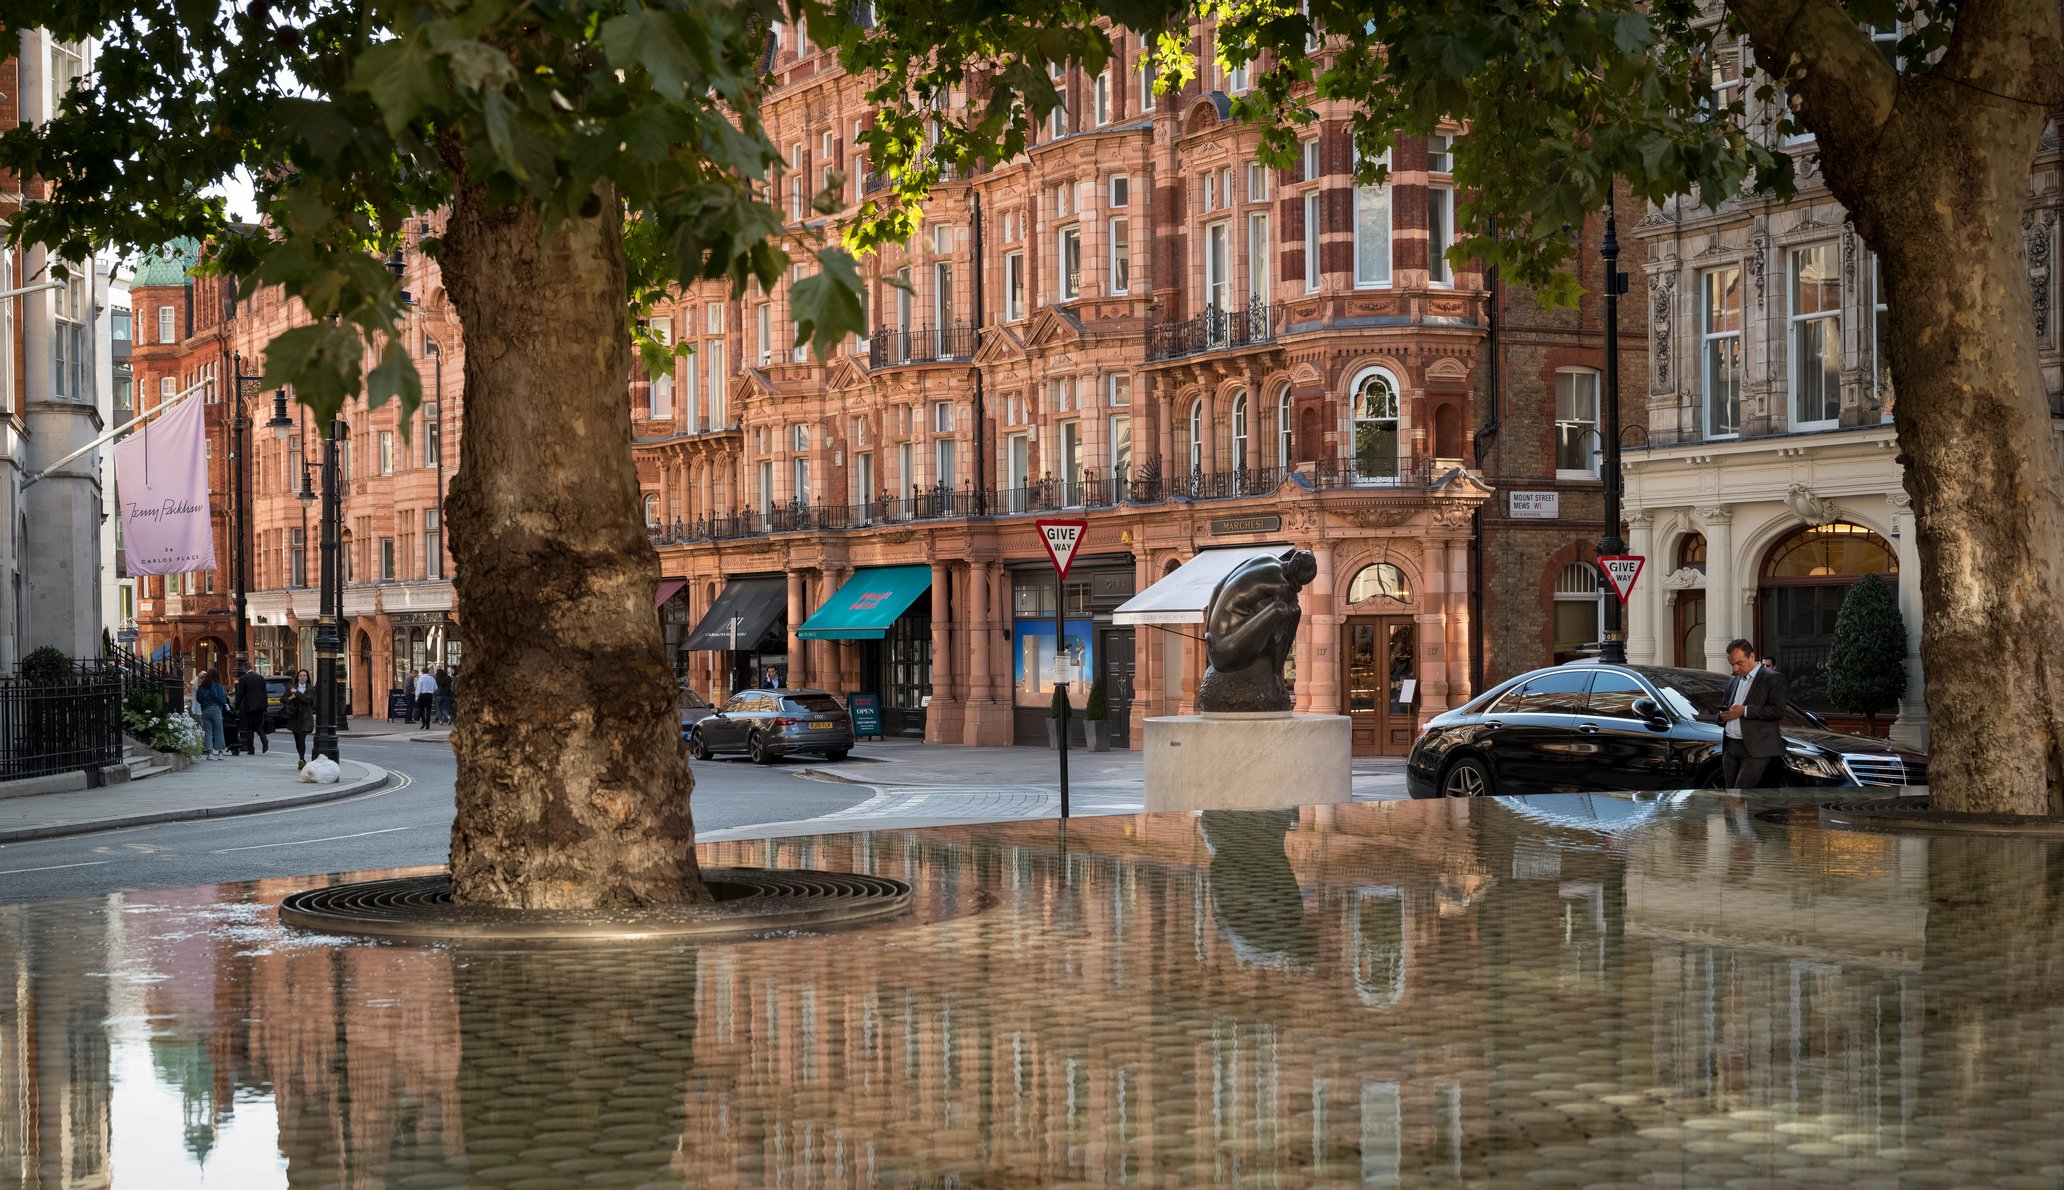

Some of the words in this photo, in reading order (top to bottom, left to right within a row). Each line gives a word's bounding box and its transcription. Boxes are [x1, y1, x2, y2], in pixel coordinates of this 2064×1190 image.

[126, 502, 159, 524] Jenny
[159, 498, 203, 522] Packham
[1223, 519, 1264, 530] MARCHESI
[1046, 528, 1076, 540] GIVE
[1053, 543, 1072, 551] WAY
[141, 557, 172, 565] CARLOS
[176, 554, 199, 562] PLACE
[1609, 562, 1635, 572] GIVE
[1106, 579, 1127, 590] GINA
[1316, 648, 1327, 656] 117
